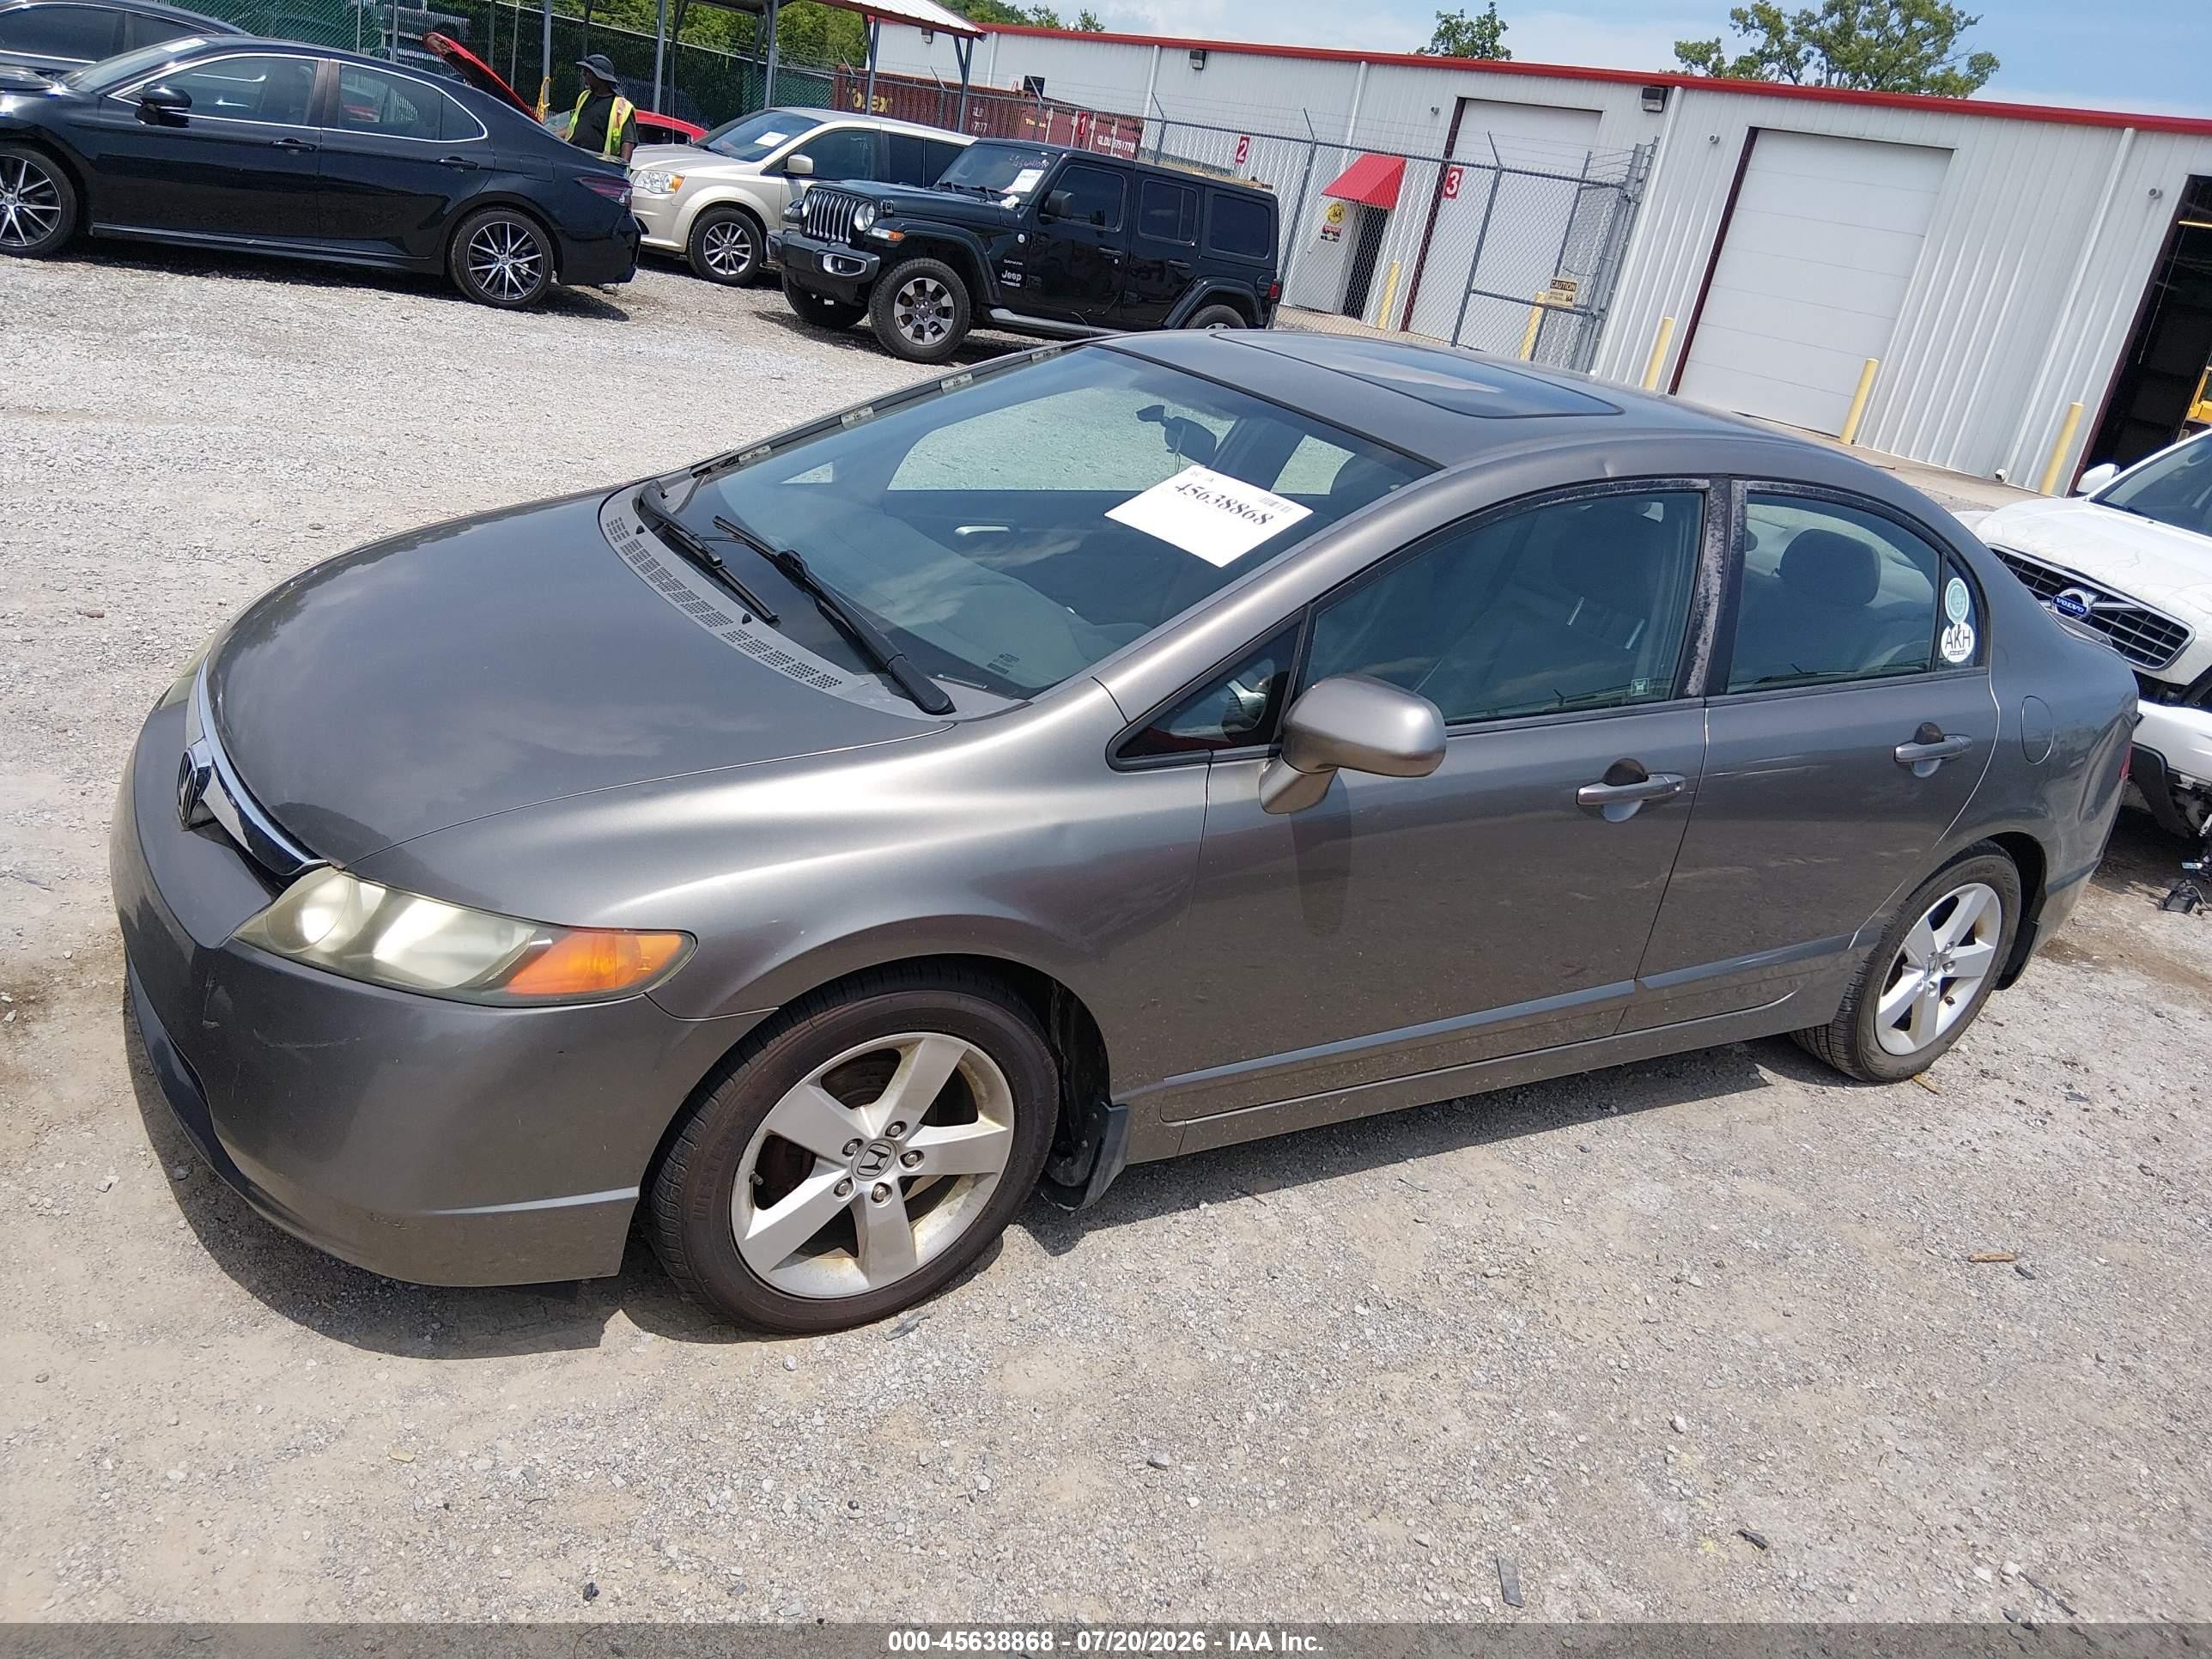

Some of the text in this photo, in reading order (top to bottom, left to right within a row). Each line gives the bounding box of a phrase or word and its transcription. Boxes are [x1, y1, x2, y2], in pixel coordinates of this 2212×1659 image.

[1238, 140, 1248, 161] 2
[1446, 172, 1459, 195] 3
[1001, 270, 1022, 282] Jeep
[1552, 280, 1576, 291] CAUTION
[1175, 483, 1274, 526] 45638868
[2056, 597, 2085, 612] VOLVO
[1945, 629, 1971, 650] AKH
